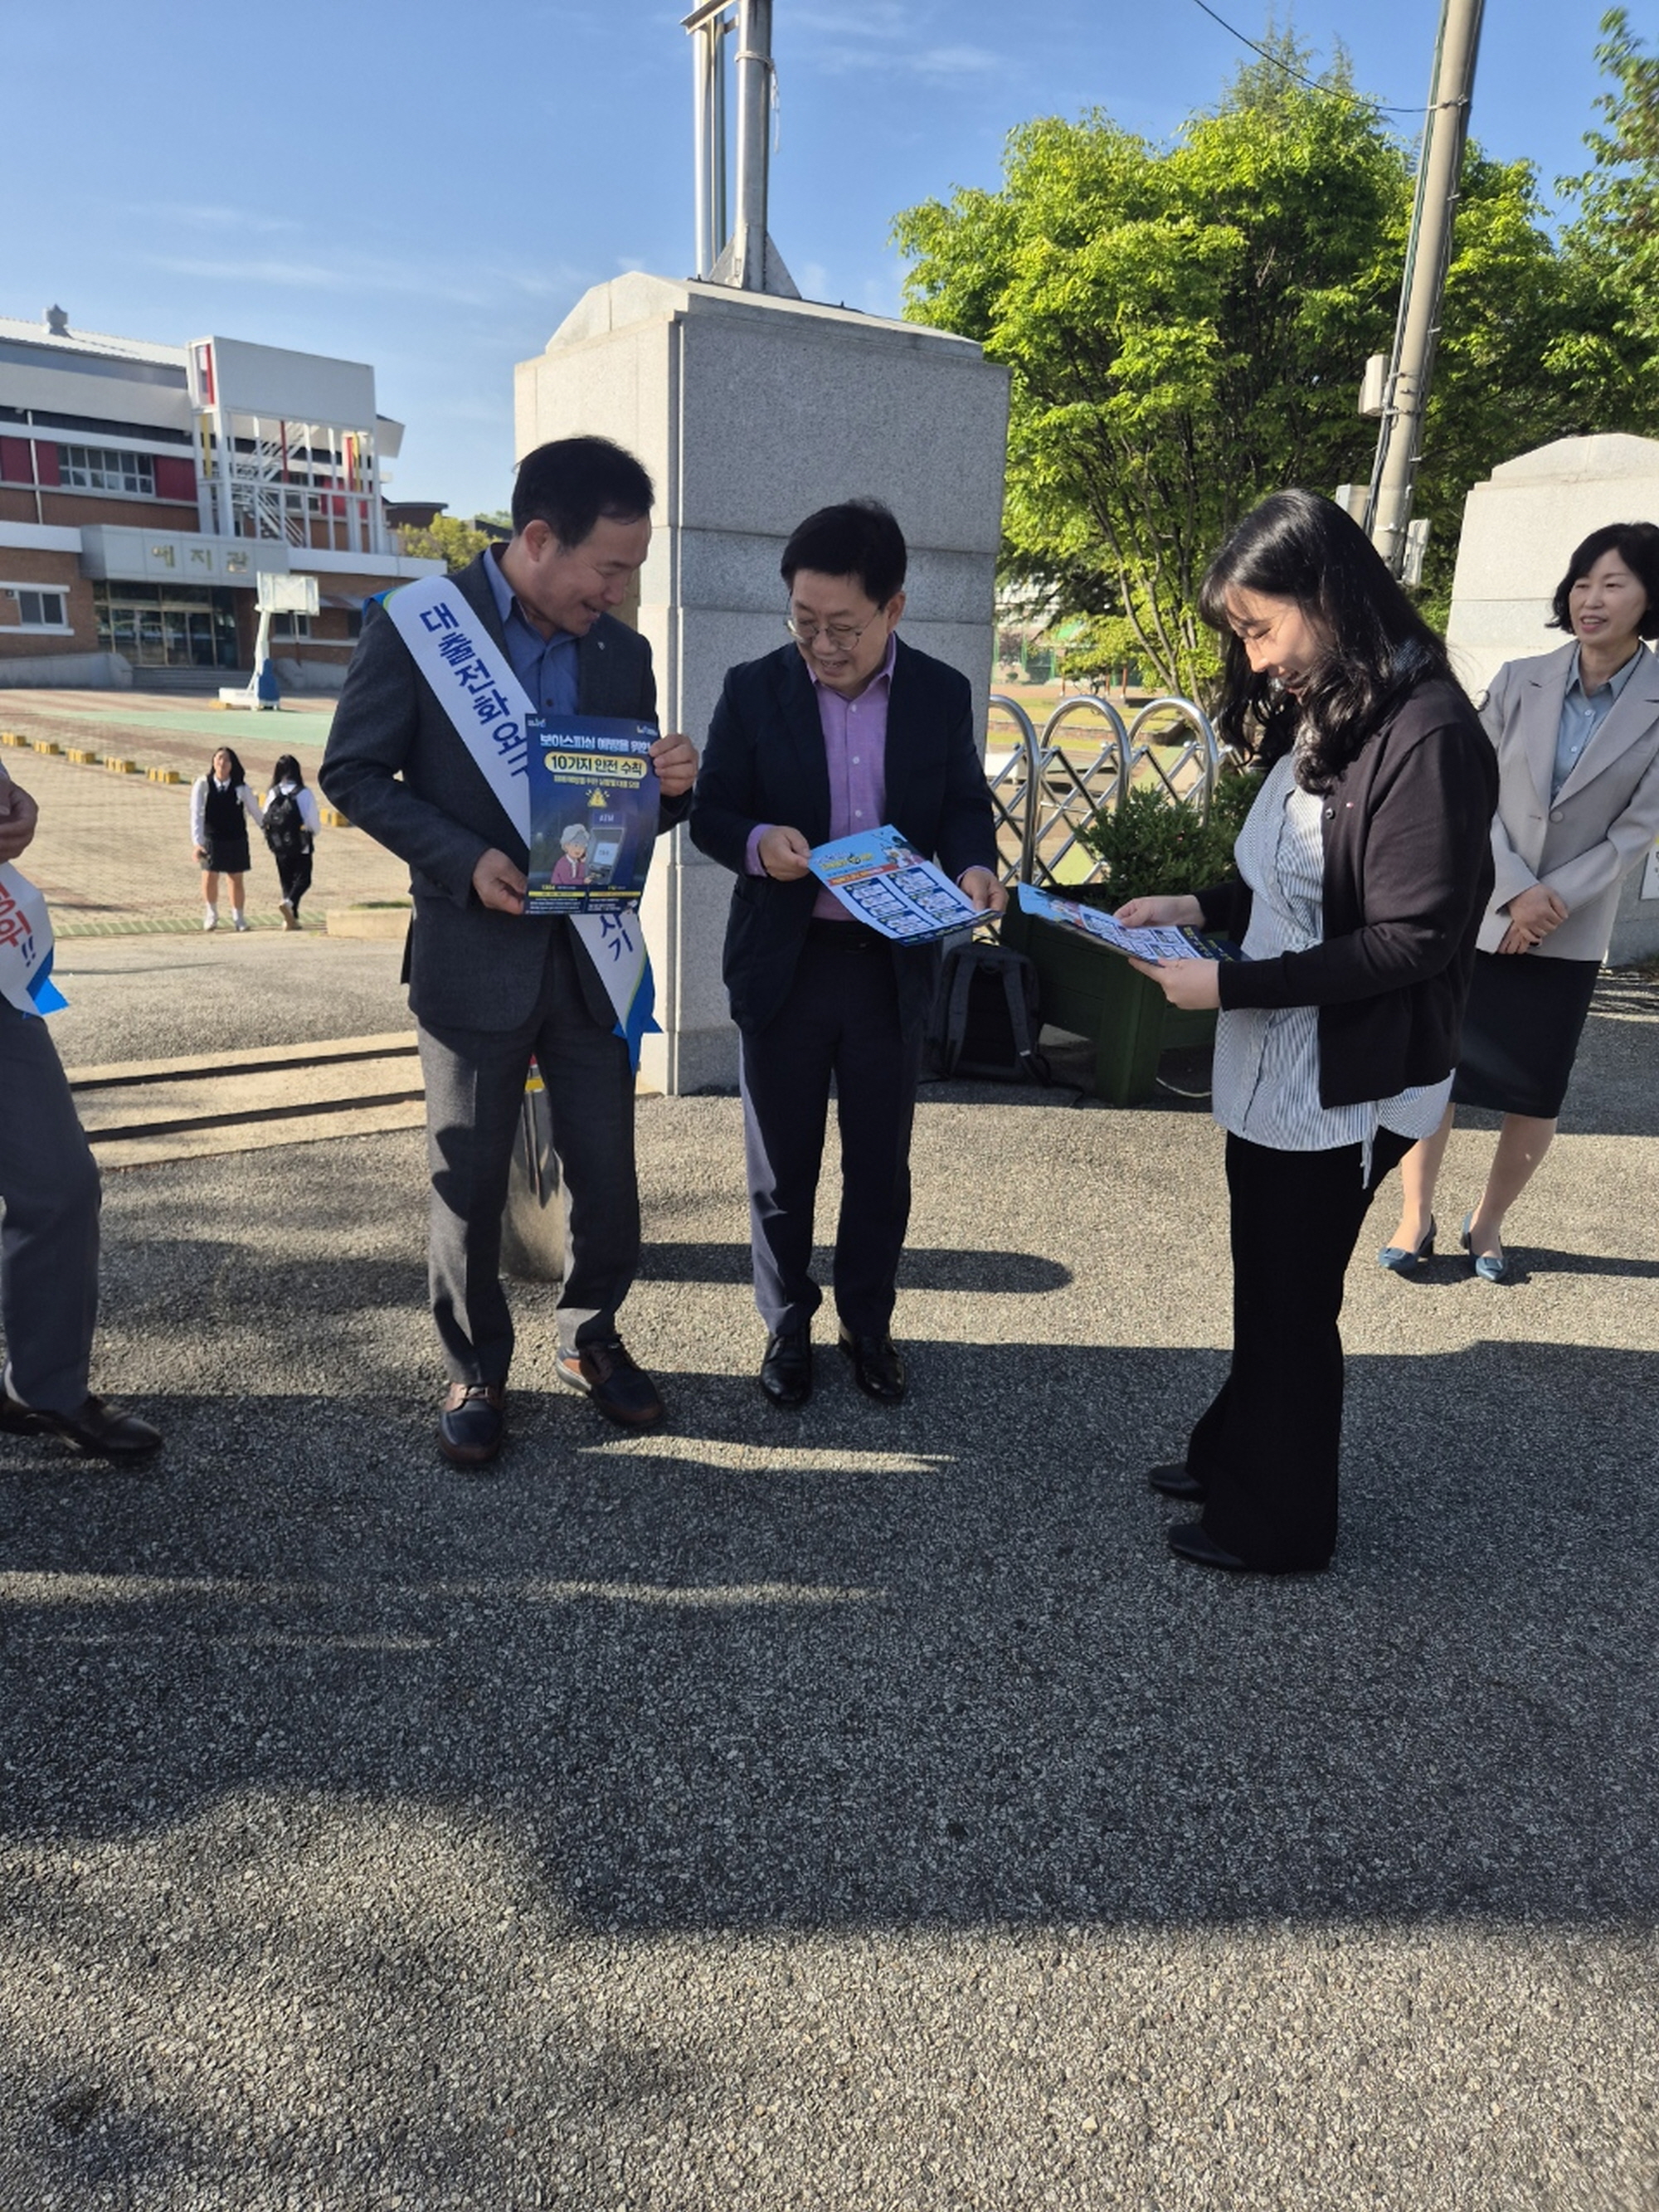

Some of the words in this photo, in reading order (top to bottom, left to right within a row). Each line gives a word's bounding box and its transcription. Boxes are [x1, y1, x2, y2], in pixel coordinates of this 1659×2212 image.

[540, 733, 595, 750] 보이스피싱
[552, 755, 591, 771] 10가지
[594, 758, 618, 774] 안전
[620, 761, 642, 775] 수칙
